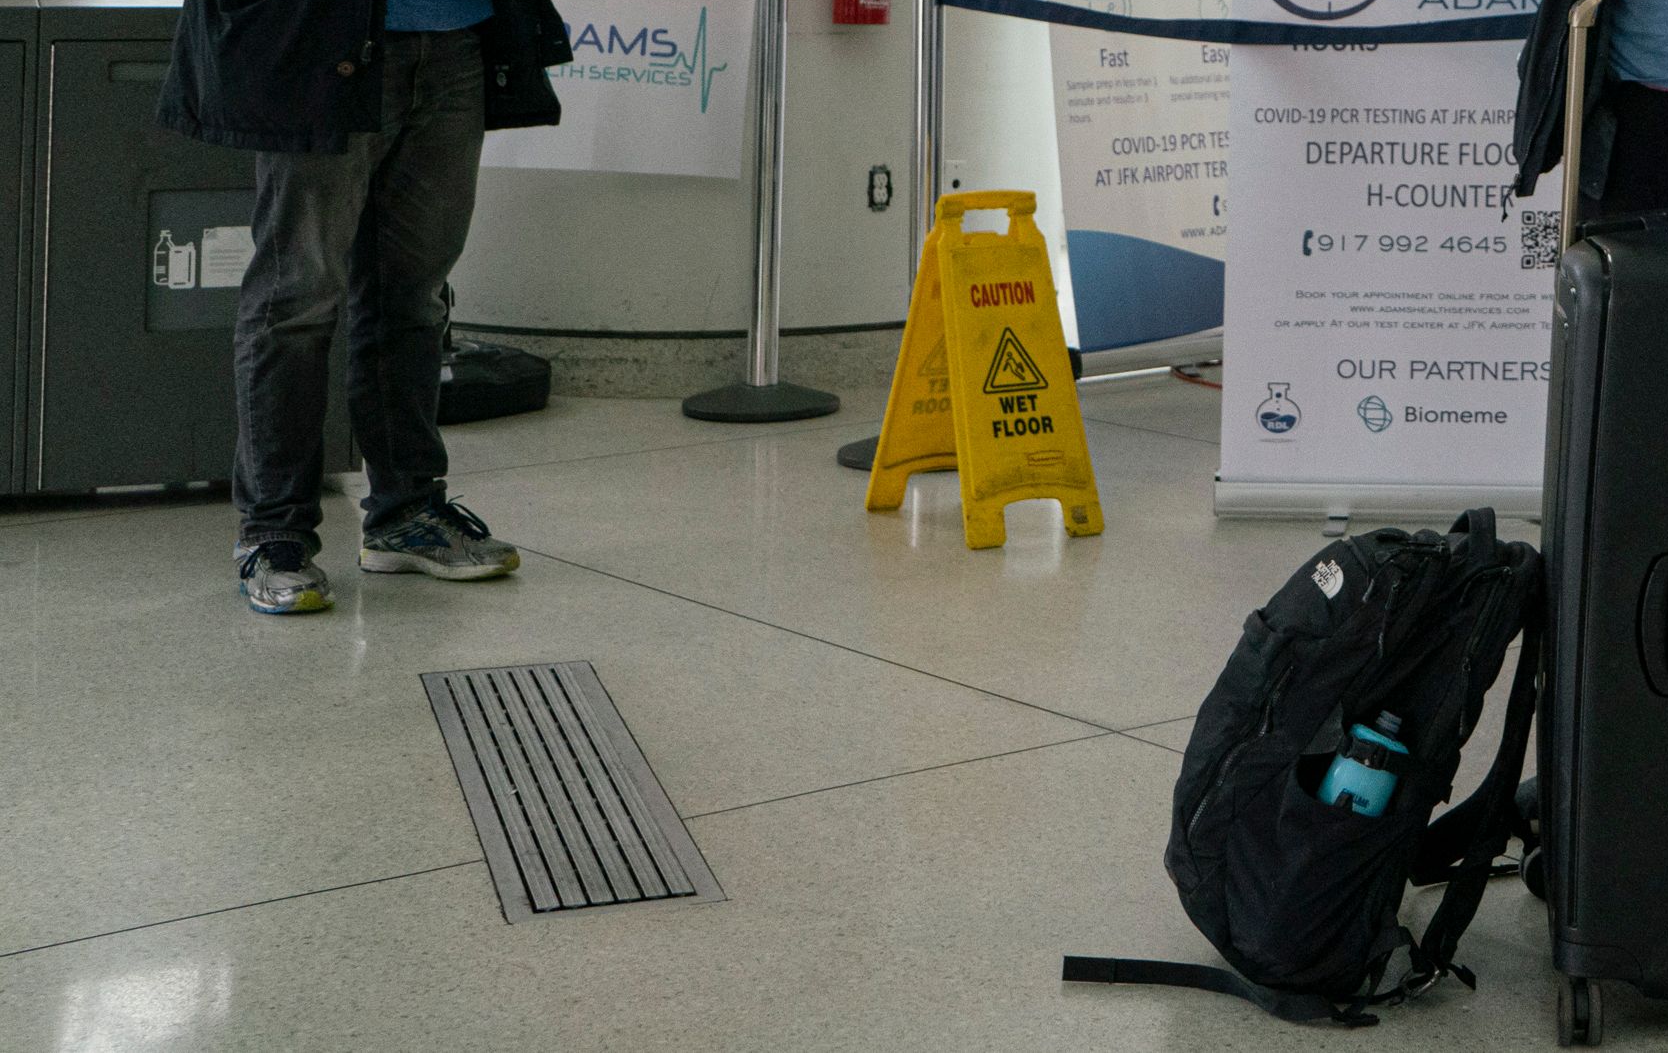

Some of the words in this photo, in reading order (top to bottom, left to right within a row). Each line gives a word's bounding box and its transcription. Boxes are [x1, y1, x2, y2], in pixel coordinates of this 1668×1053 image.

[564, 22, 678, 58] AMS
[1100, 48, 1130, 67] Fast
[1202, 45, 1231, 67] Easy
[588, 65, 692, 86] SERVICES
[1255, 107, 1326, 124] COVID-19
[1331, 108, 1360, 124] PCR
[1364, 109, 1427, 124] TESTING
[1430, 109, 1450, 124] AT
[1452, 109, 1477, 125] JFK
[1112, 134, 1177, 155] COVID-19
[1180, 133, 1205, 150] PCR
[1305, 141, 1450, 165] DEPARTURE
[1095, 169, 1113, 187] AT
[1117, 167, 1140, 186] JFK
[1142, 162, 1200, 183] AIRPORT
[1205, 160, 1228, 178] TER
[1366, 184, 1515, 208] H-COUNTER
[1318, 234, 1368, 252] 917
[1378, 234, 1429, 253] 992
[1440, 235, 1508, 254] 4645
[970, 281, 1036, 308] CAUTION
[1295, 290, 1327, 299] BOOK
[1363, 291, 1434, 300] APPOINTMENT
[1437, 293, 1475, 301] ONLINE
[1479, 293, 1510, 301] FROM
[1274, 320, 1290, 328] OR
[1374, 320, 1399, 329] TEST
[1402, 321, 1443, 329] CENTER
[1336, 359, 1397, 380] OUR
[998, 395, 1038, 413] WET
[1404, 406, 1508, 424] Biomeme
[993, 416, 1054, 438] FLOOR
